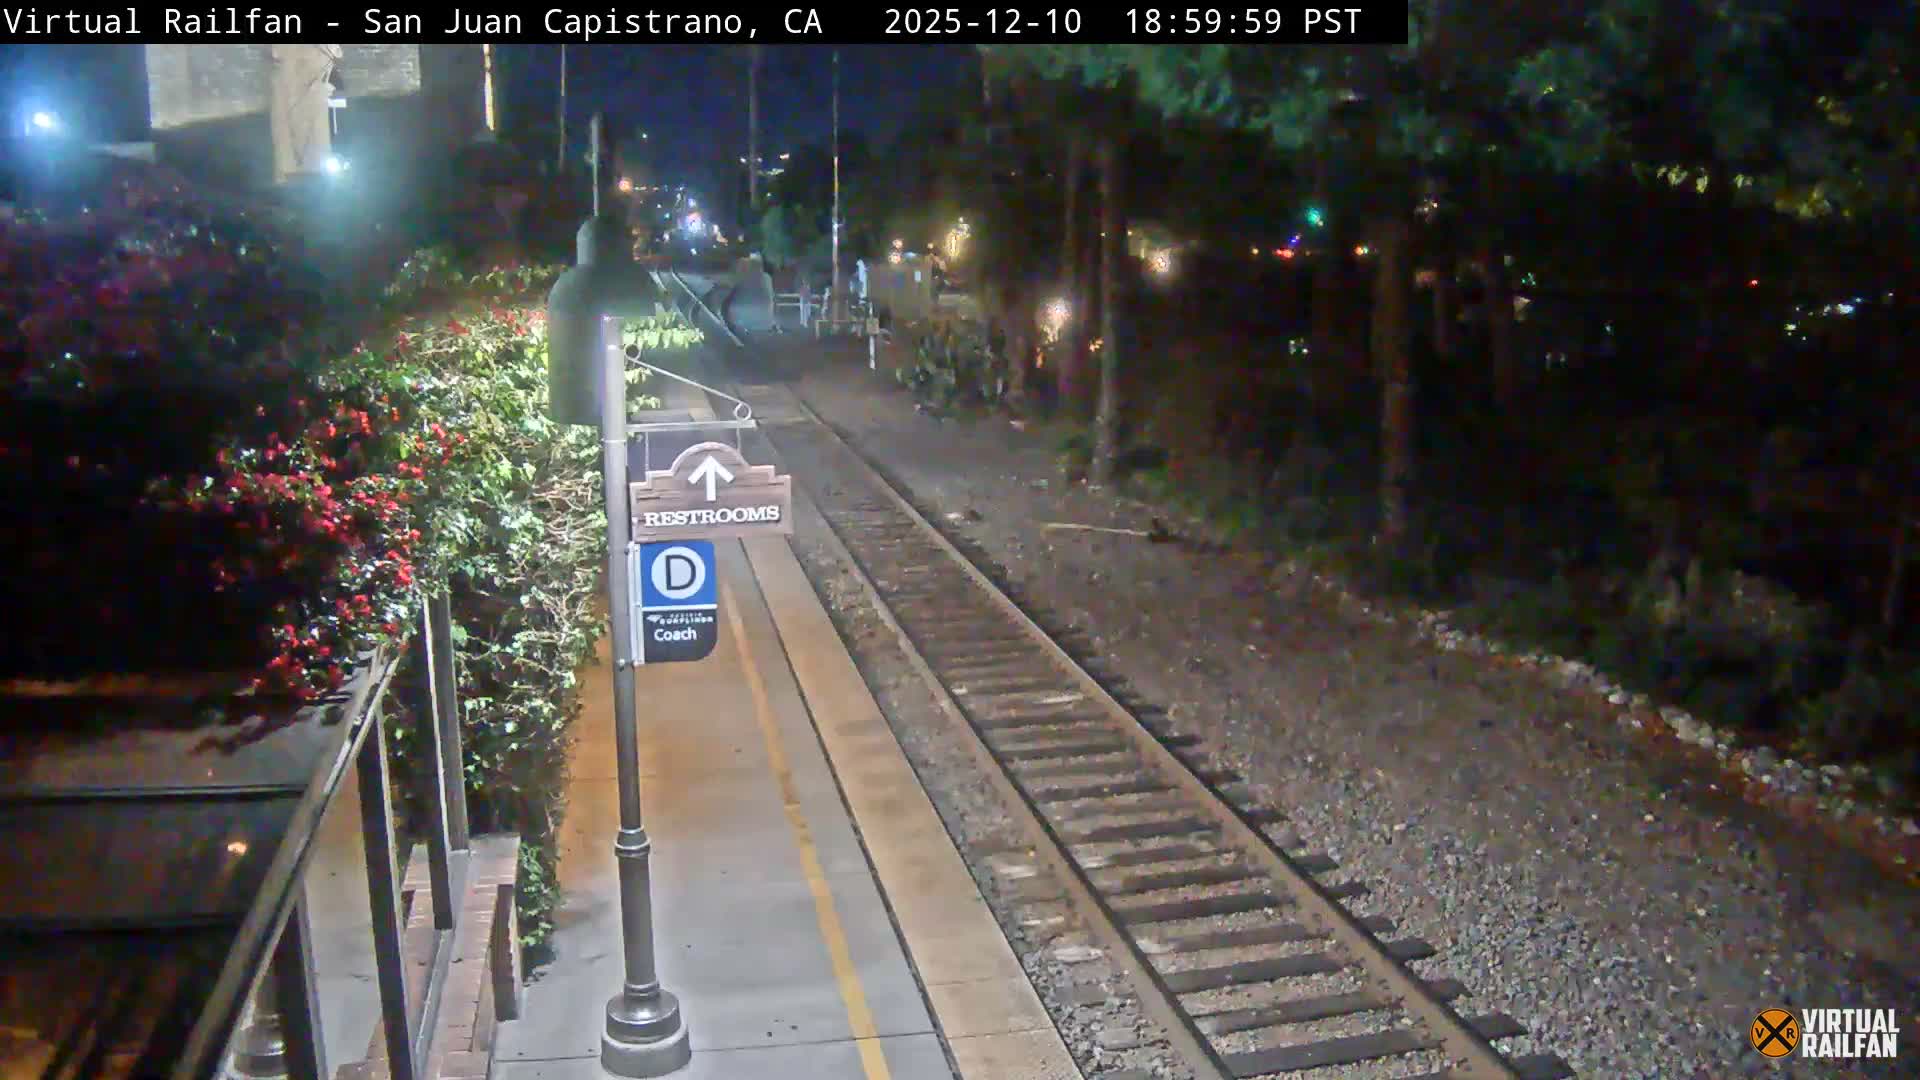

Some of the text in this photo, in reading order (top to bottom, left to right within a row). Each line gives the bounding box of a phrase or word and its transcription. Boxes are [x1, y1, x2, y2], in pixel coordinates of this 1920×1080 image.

[643, 505, 780, 527] RESTROOMS
[665, 554, 696, 591] D
[654, 627, 697, 641] Coach
